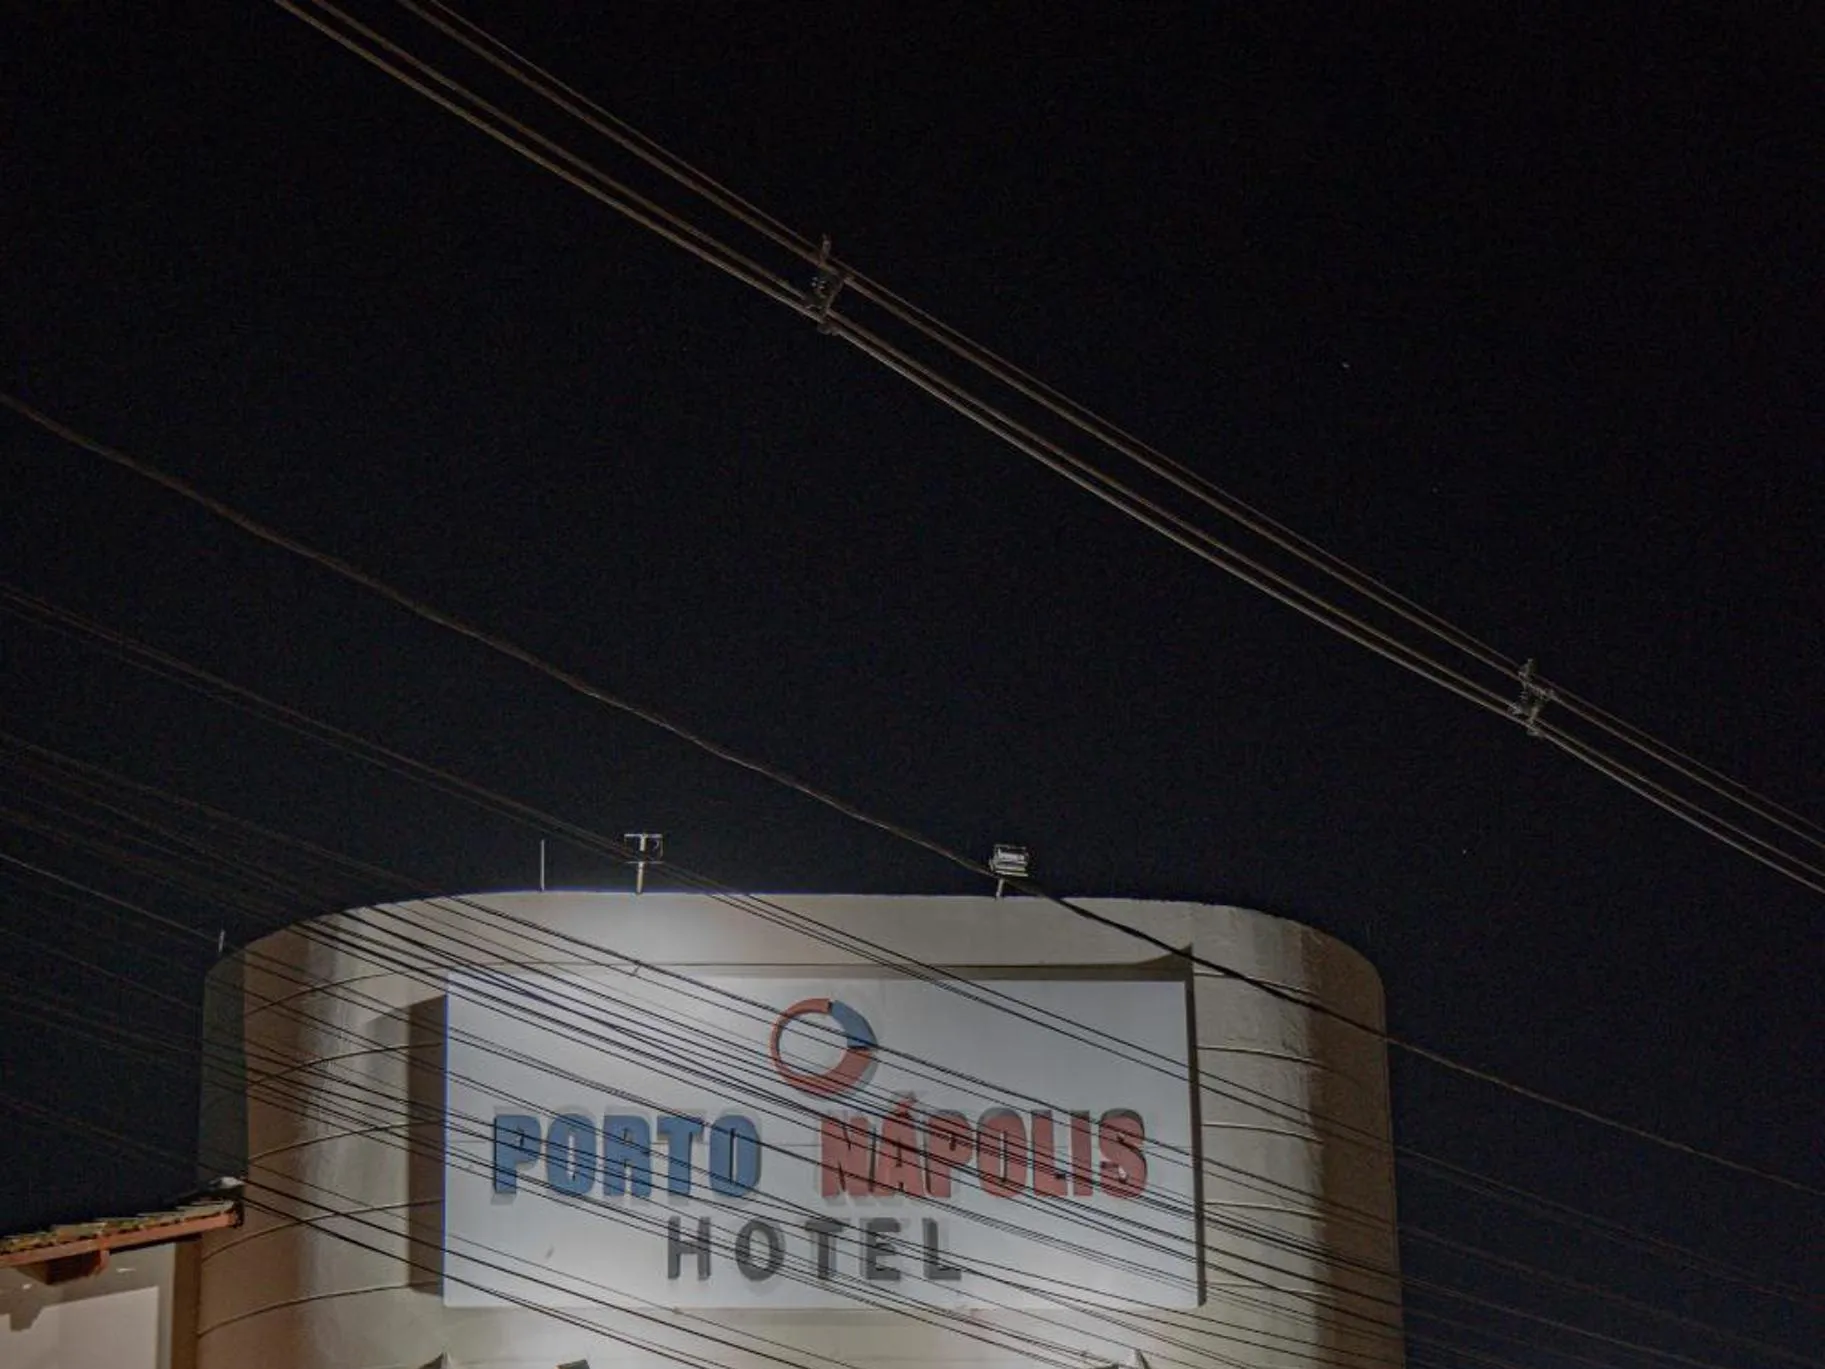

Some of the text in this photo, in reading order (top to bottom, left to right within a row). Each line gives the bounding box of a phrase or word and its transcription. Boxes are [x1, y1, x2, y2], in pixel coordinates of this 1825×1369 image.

[493, 1091, 1148, 1198] PORTO NÁPOLIS
[667, 1216, 962, 1281] HOTEL
